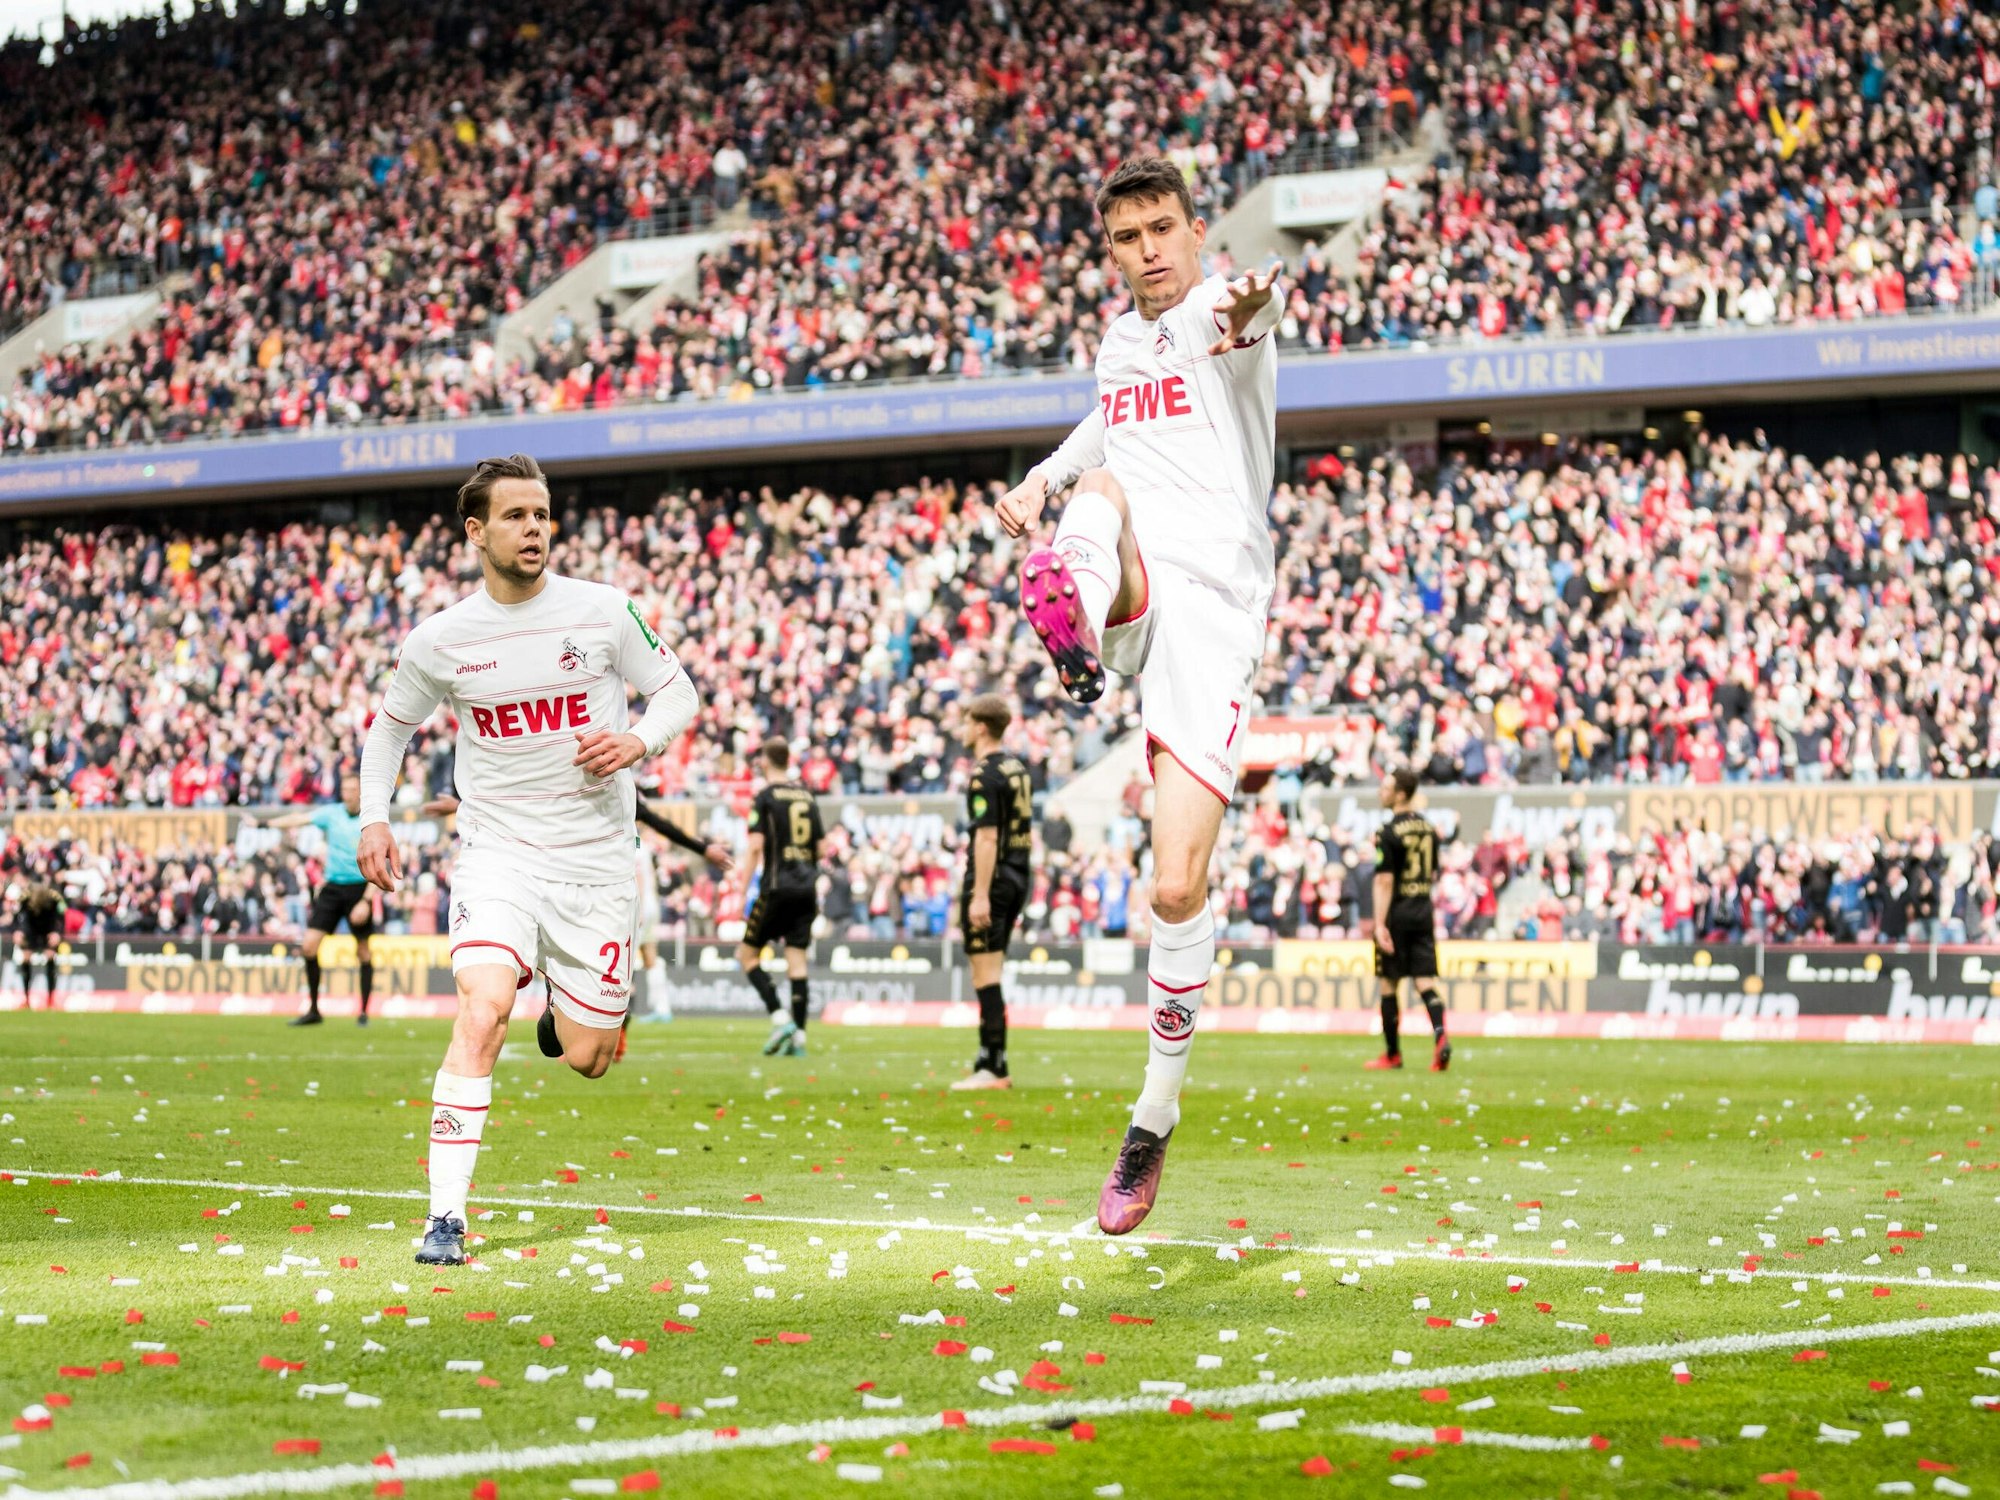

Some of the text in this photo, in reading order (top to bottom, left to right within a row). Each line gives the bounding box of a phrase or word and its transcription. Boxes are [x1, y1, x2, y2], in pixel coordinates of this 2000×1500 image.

[1447, 350, 1604, 394] SAUREN
[1816, 335, 1863, 365] Wir
[1101, 375, 1192, 428] REWE
[340, 434, 456, 471] SAUREN
[456, 660, 497, 674] uhlsport
[471, 692, 591, 738] REWE
[1225, 700, 1240, 750] 7
[788, 801, 812, 845] 6
[1490, 793, 1617, 844] bwin
[1644, 792, 1961, 842] SPORTWETTEN
[1402, 834, 1433, 880] 31
[138, 965, 415, 993] SPORTWTTEN
[599, 934, 631, 984] 21
[1202, 974, 1569, 1011] PORTWTTEN
[1645, 976, 1800, 1017] bwin
